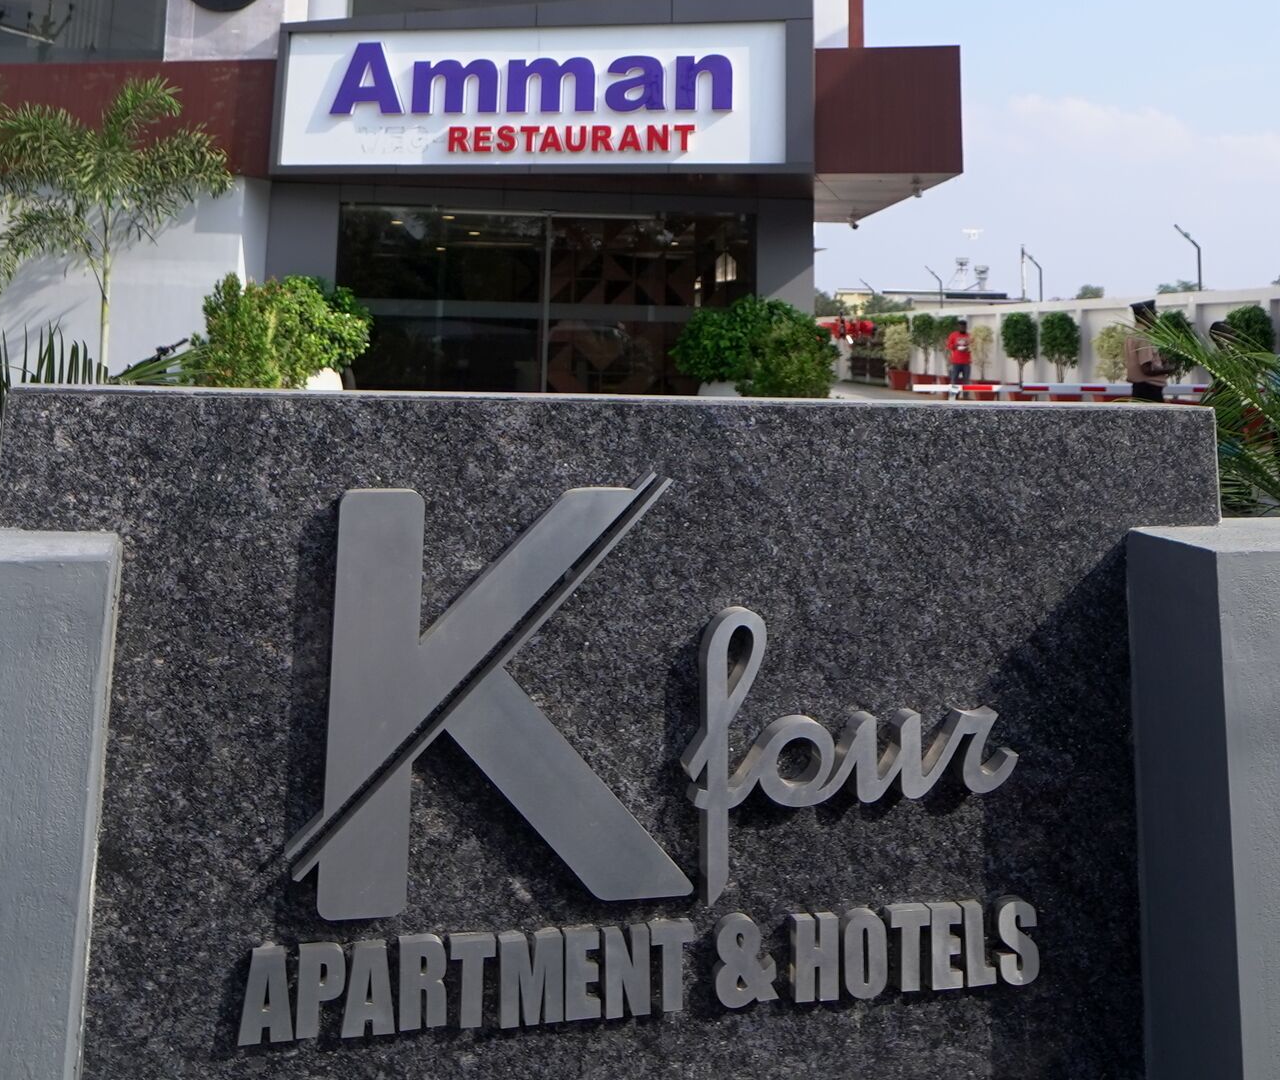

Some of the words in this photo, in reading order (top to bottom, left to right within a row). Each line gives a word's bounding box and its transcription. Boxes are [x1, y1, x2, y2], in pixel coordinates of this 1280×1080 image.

[329, 41, 734, 115] Amman
[447, 124, 697, 154] RESTAURANT
[284, 471, 694, 921] K
[680, 606, 1019, 907] four
[237, 918, 695, 1046] APARTMENT
[716, 912, 777, 1008] &
[789, 895, 1040, 1003] HOTELS
